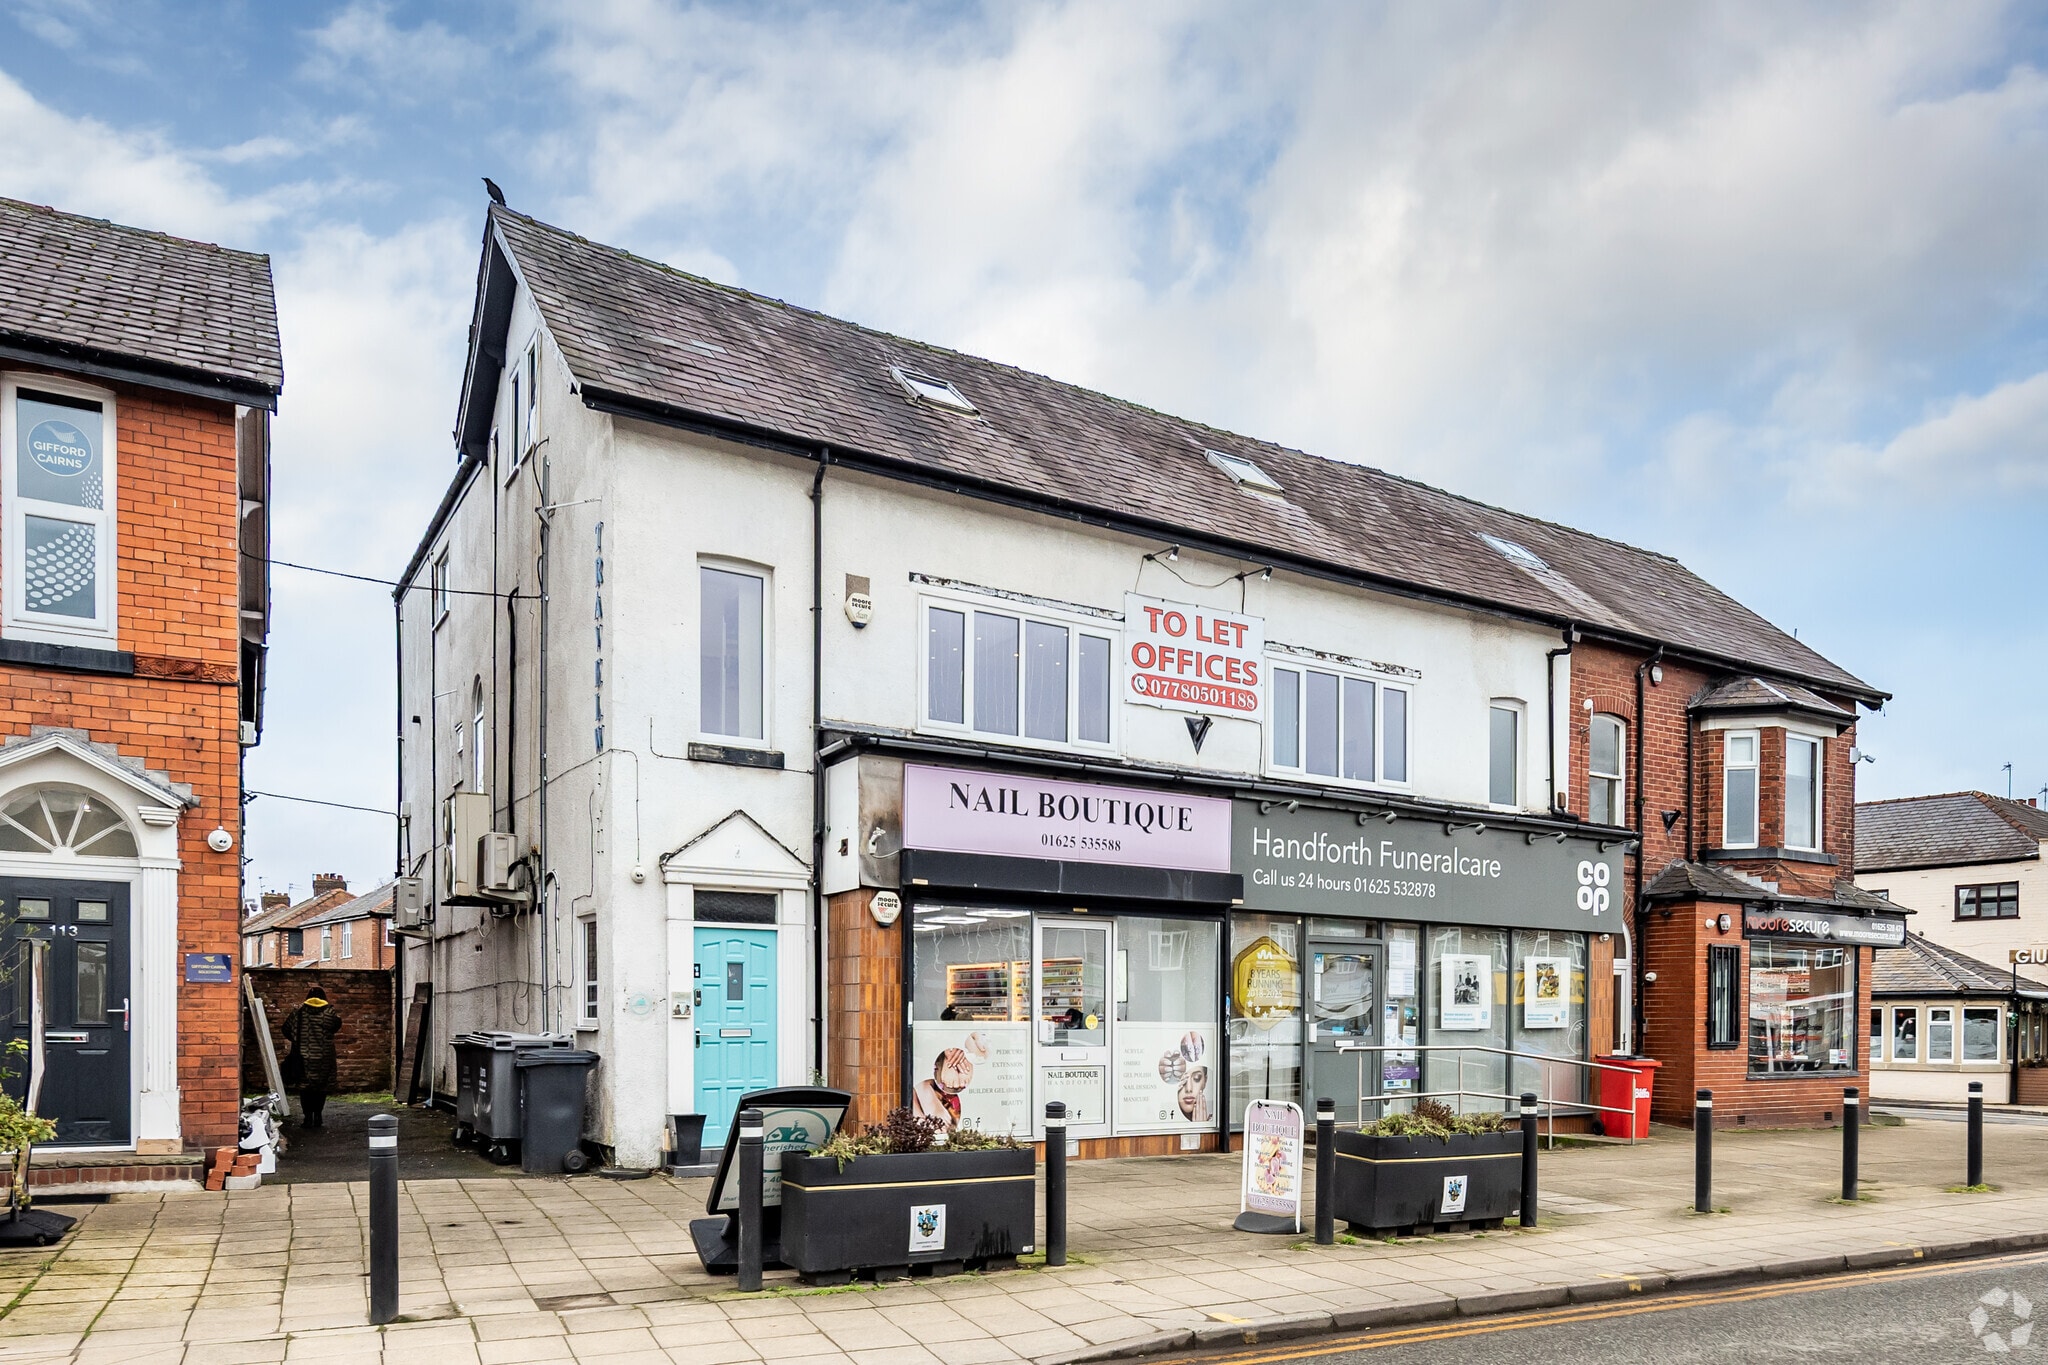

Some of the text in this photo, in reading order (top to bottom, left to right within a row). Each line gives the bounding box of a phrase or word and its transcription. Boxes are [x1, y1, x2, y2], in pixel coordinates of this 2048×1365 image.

[33, 441, 86, 457] GIFFORD
[37, 453, 83, 469] CAIRNS
[852, 597, 872, 605] moore
[1143, 605, 1248, 648] TO LET
[1131, 642, 1258, 686] OFFICES
[1150, 679, 1256, 710] 07780501188
[949, 782, 1193, 834] NAIL BOUTIQUE
[1041, 833, 1121, 852] 01625 535588
[1253, 827, 1501, 878] Handforth Funeralcare
[1253, 868, 1435, 898] Call us 24 hours 01625 532878
[877, 896, 898, 904] moore
[49, 924, 78, 937] 113
[2015, 949, 2047, 963] GIU
[1250, 969, 1280, 978] 8 YEARS
[1247, 978, 1283, 989] RUNNING
[1047, 1071, 1098, 1079] NAIL BOUTIQUE
[1264, 1109, 1286, 1121] NAIL
[1252, 1122, 1297, 1137] BOUTIQUE
[763, 1143, 807, 1152] herished
